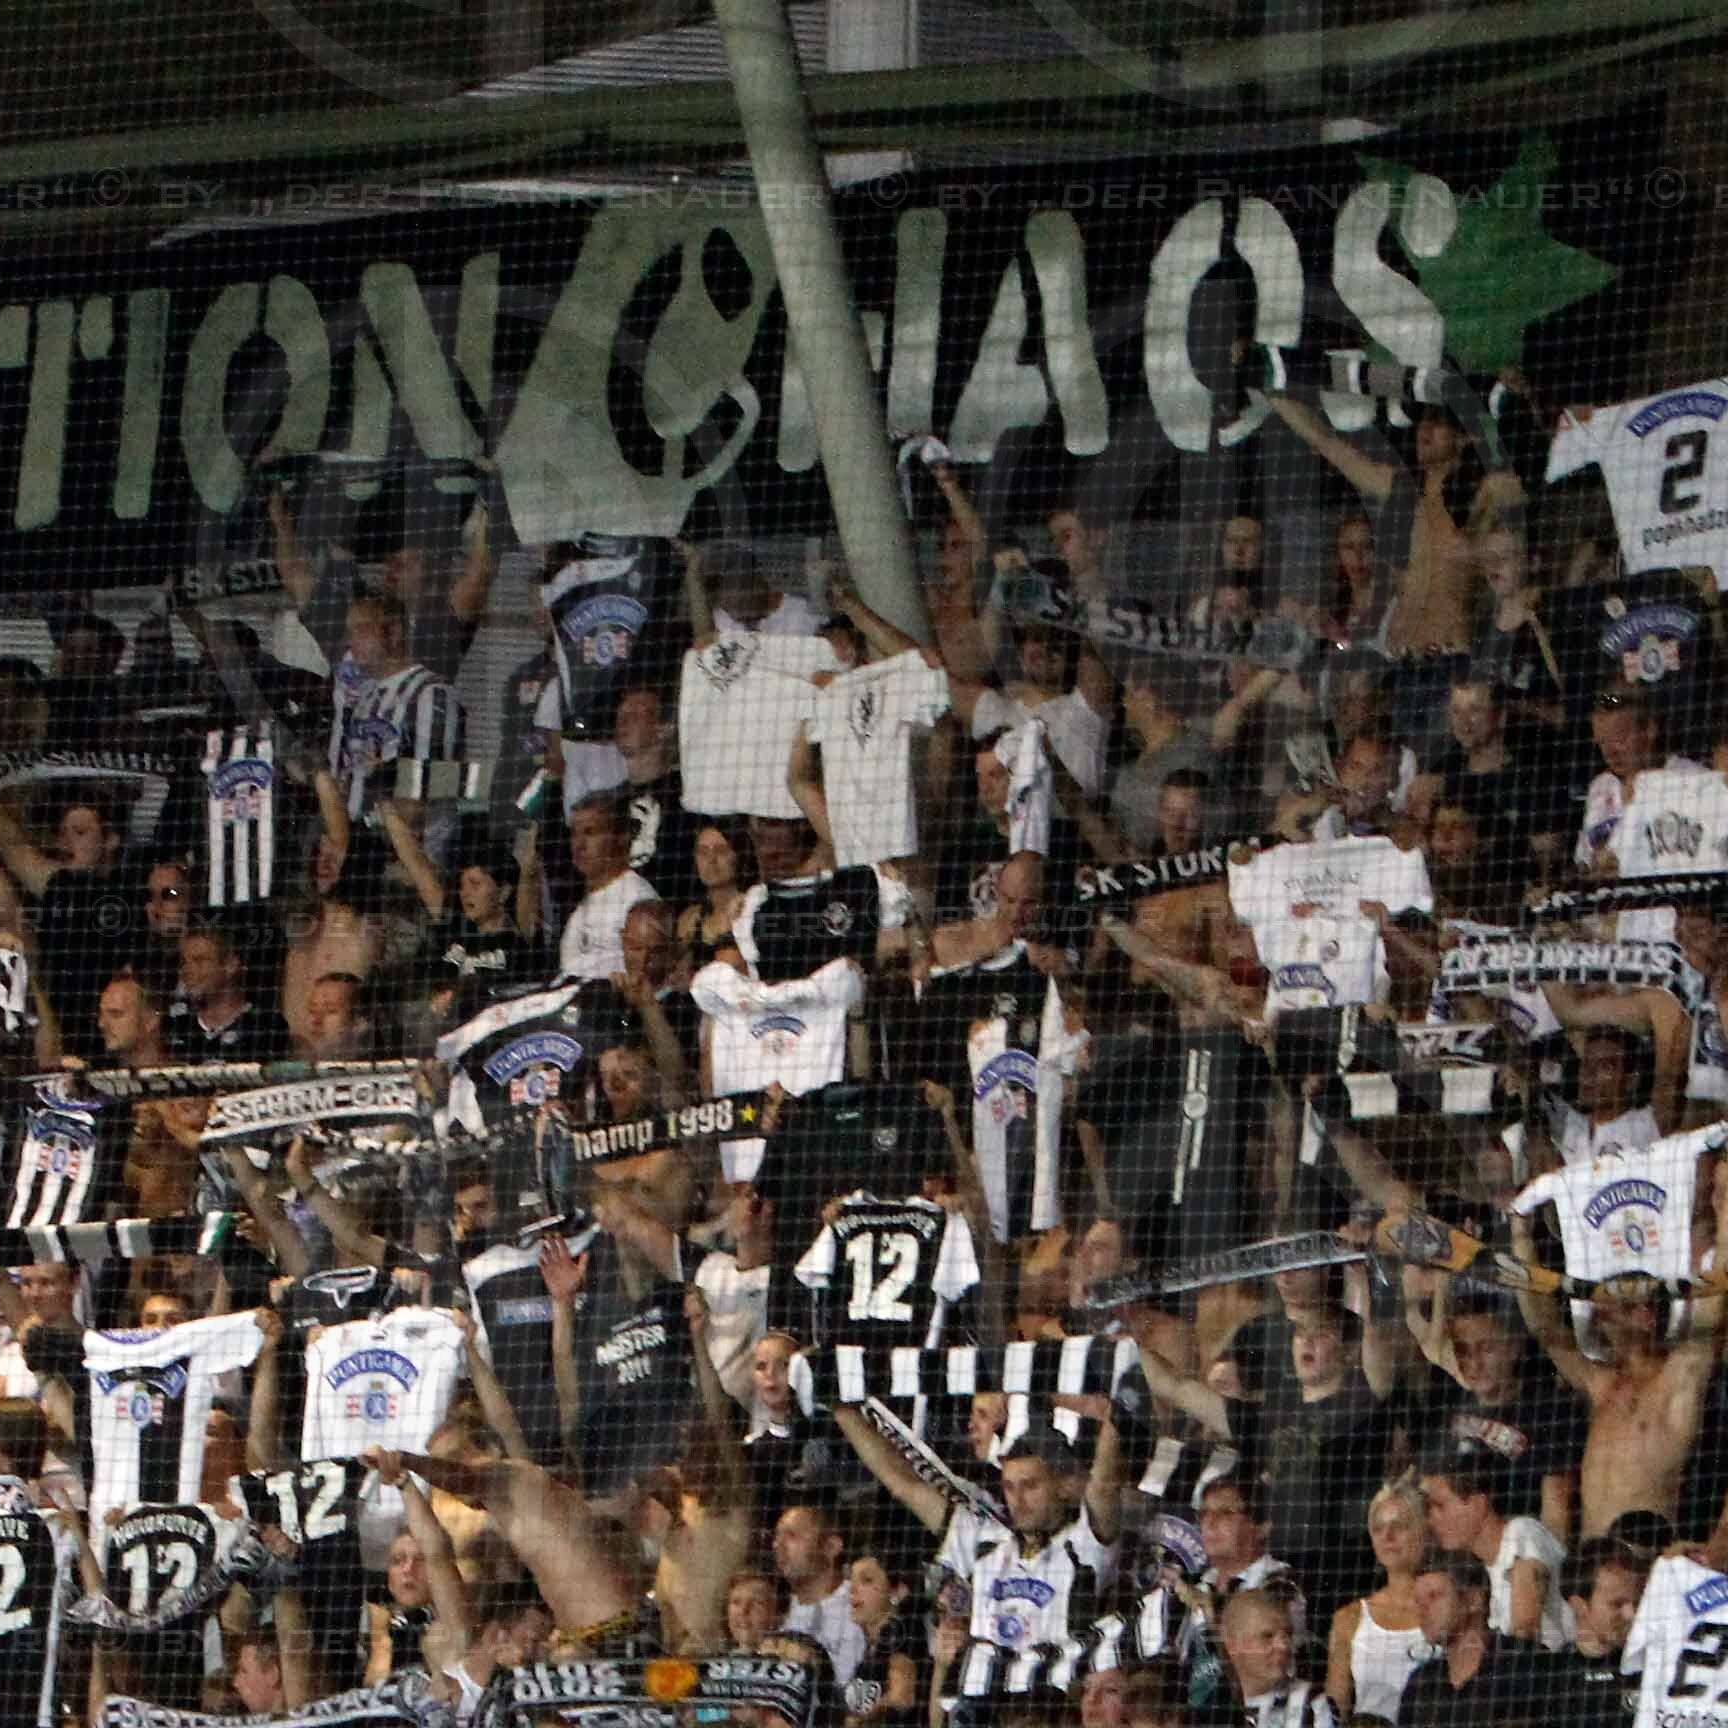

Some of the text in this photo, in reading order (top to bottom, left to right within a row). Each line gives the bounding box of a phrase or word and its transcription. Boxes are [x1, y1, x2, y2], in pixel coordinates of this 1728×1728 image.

[1660, 430, 1709, 514] 2
[484, 1032, 584, 1085] PUNTIGAMER
[844, 1230, 920, 1322] 12
[326, 1350, 418, 1392] PUNTIGAMER
[265, 1461, 347, 1544] 12
[121, 1541, 198, 1616] 12
